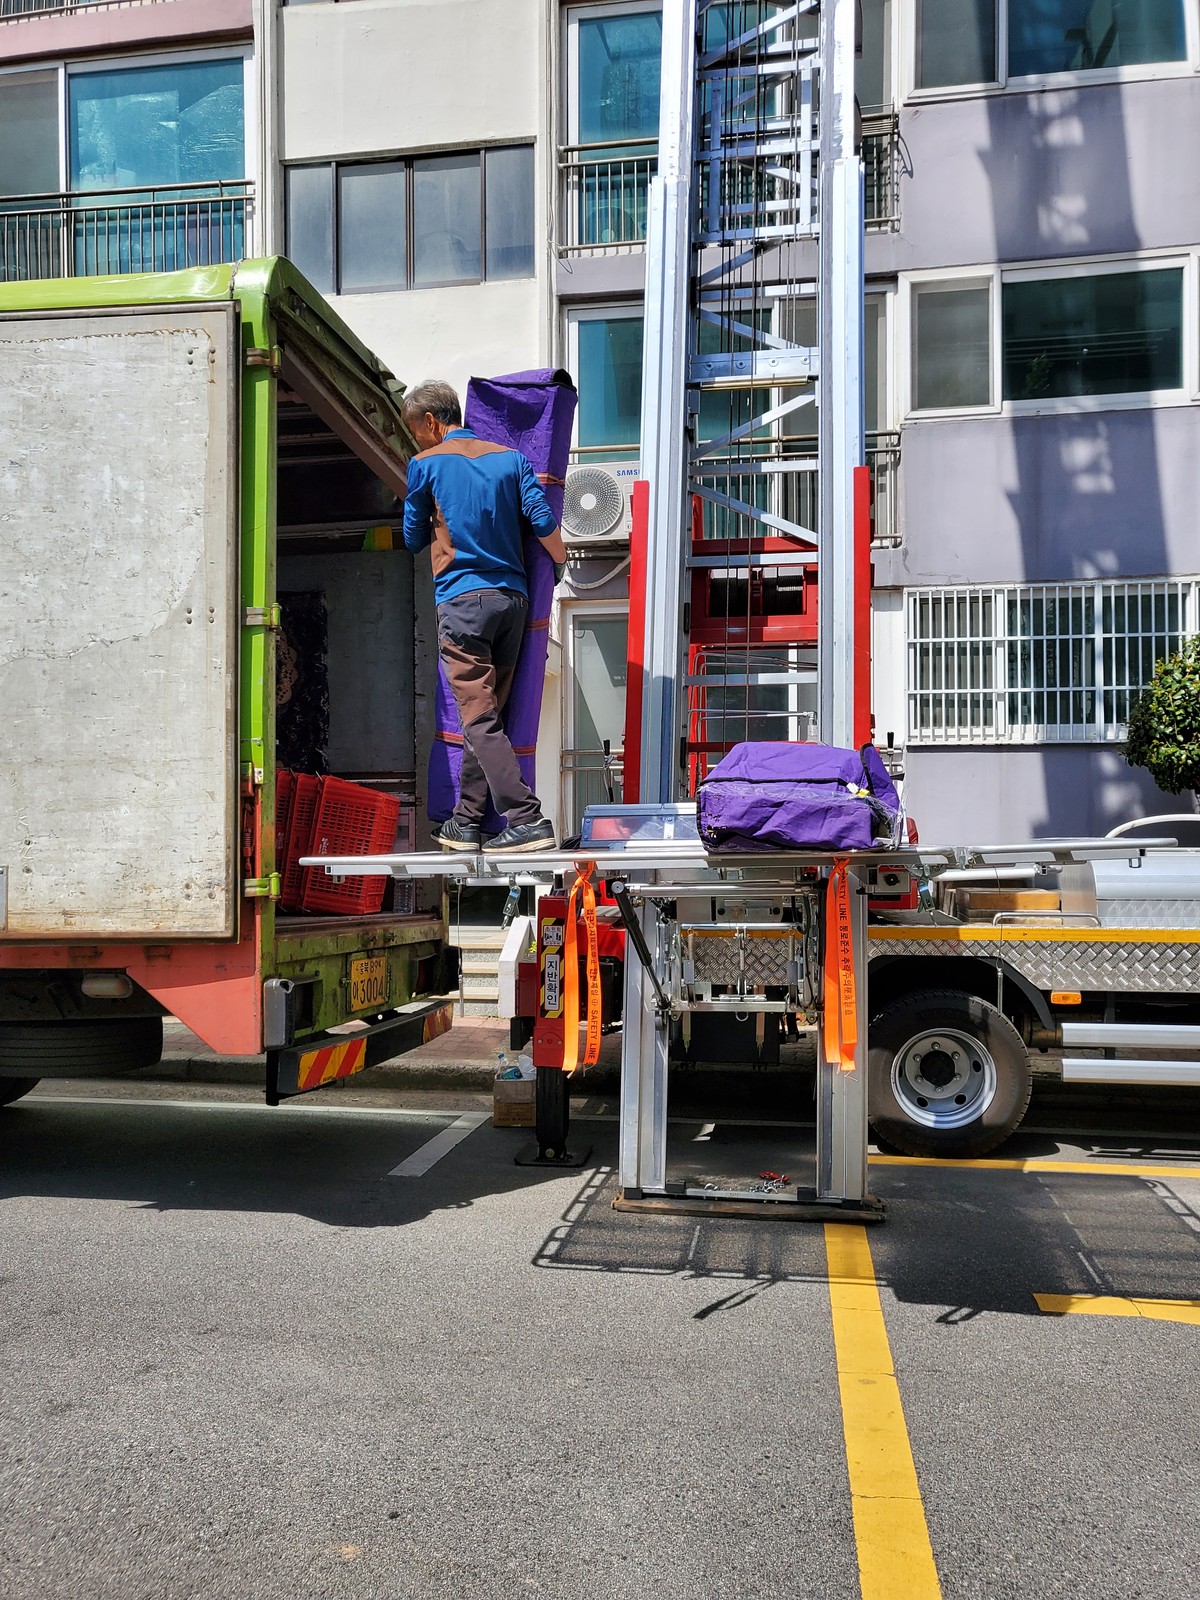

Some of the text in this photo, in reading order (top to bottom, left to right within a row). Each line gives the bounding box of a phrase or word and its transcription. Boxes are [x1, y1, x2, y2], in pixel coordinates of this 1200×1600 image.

[616, 468, 640, 476] SAMS
[838, 903, 848, 921] LINE
[839, 925, 849, 954] 통로준수
[546, 960, 558, 1006] 지반확인
[590, 1009, 599, 1040] SAFETY
[588, 1043, 597, 1060] LINE
